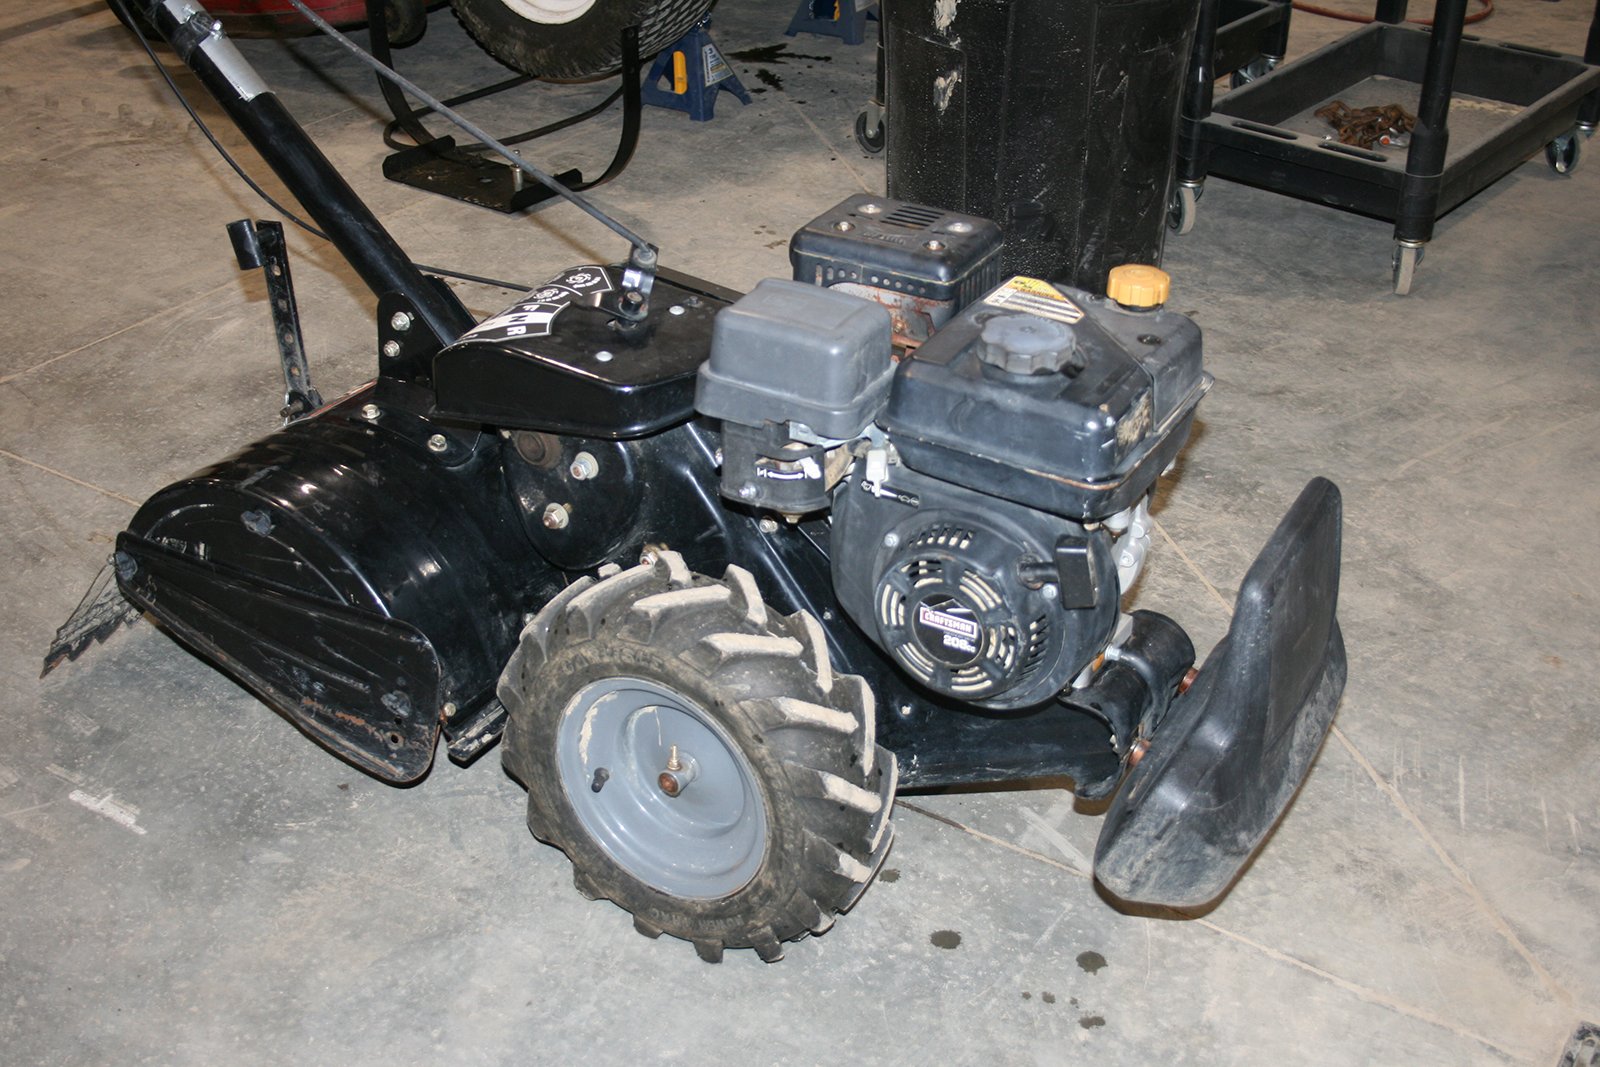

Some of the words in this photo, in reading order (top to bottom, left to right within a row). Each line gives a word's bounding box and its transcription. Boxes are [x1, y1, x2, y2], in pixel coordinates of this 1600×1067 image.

[510, 314, 528, 323] N
[506, 325, 527, 336] R
[923, 610, 974, 634] CRAFTSMAN
[942, 634, 977, 653] 208cc
